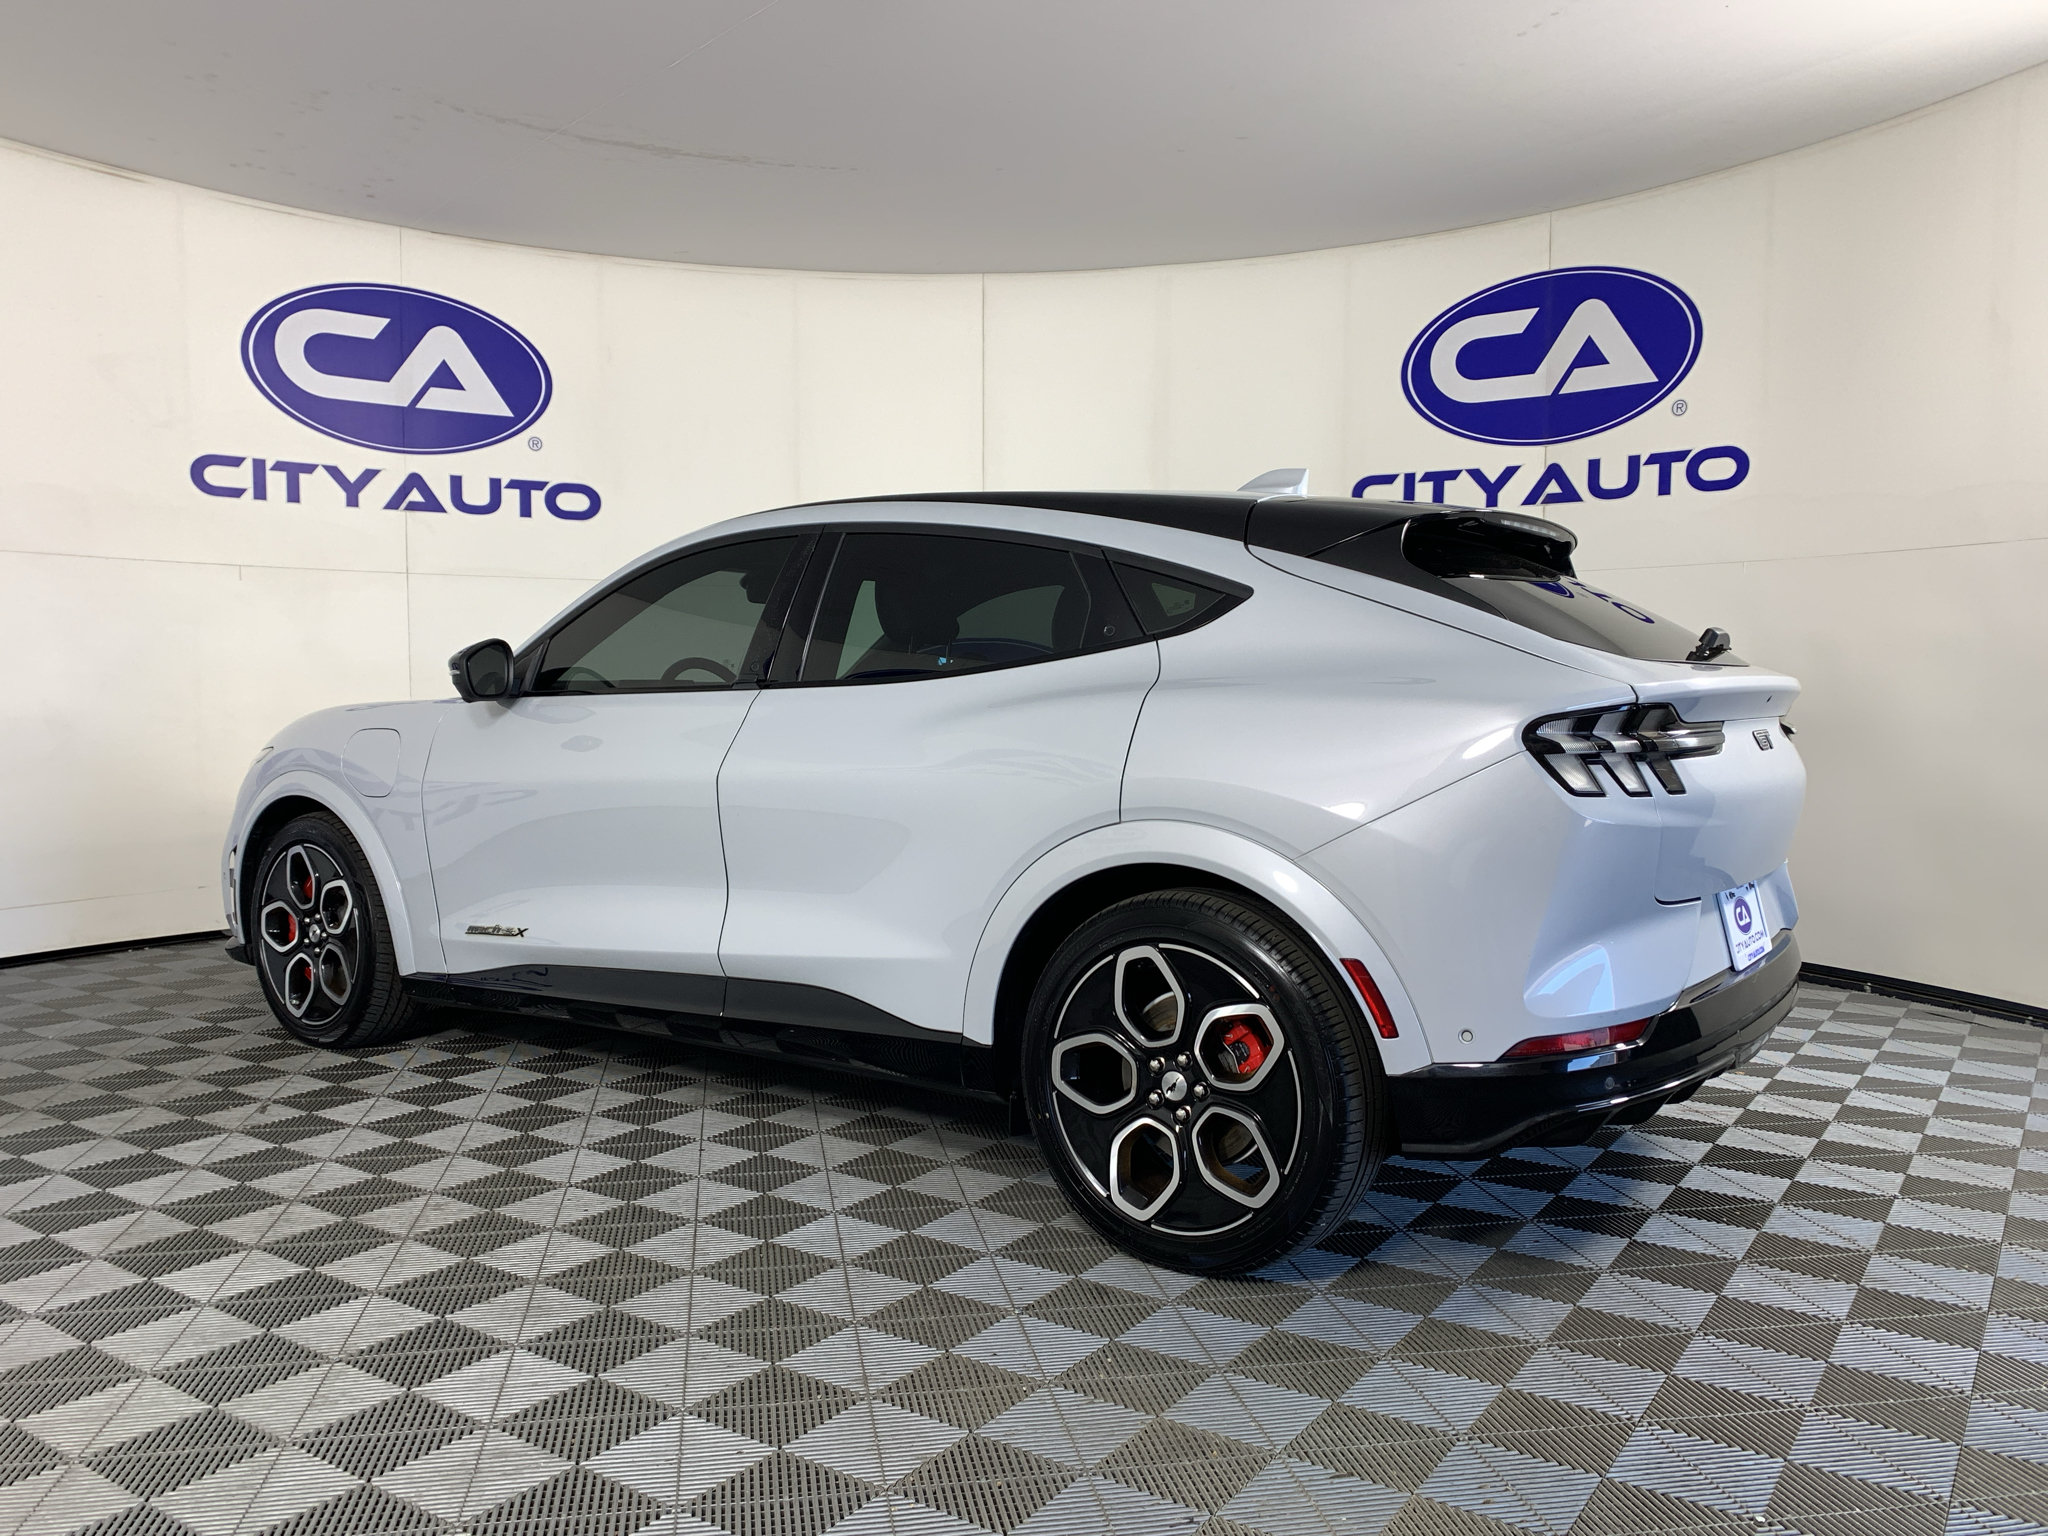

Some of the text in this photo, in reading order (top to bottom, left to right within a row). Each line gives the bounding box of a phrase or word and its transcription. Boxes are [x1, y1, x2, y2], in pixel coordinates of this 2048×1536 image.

[274, 308, 515, 418] CA
[1430, 298, 1659, 404] CA
[190, 454, 602, 521] CITY AUTO
[1352, 445, 1751, 508] CITY AUTO
